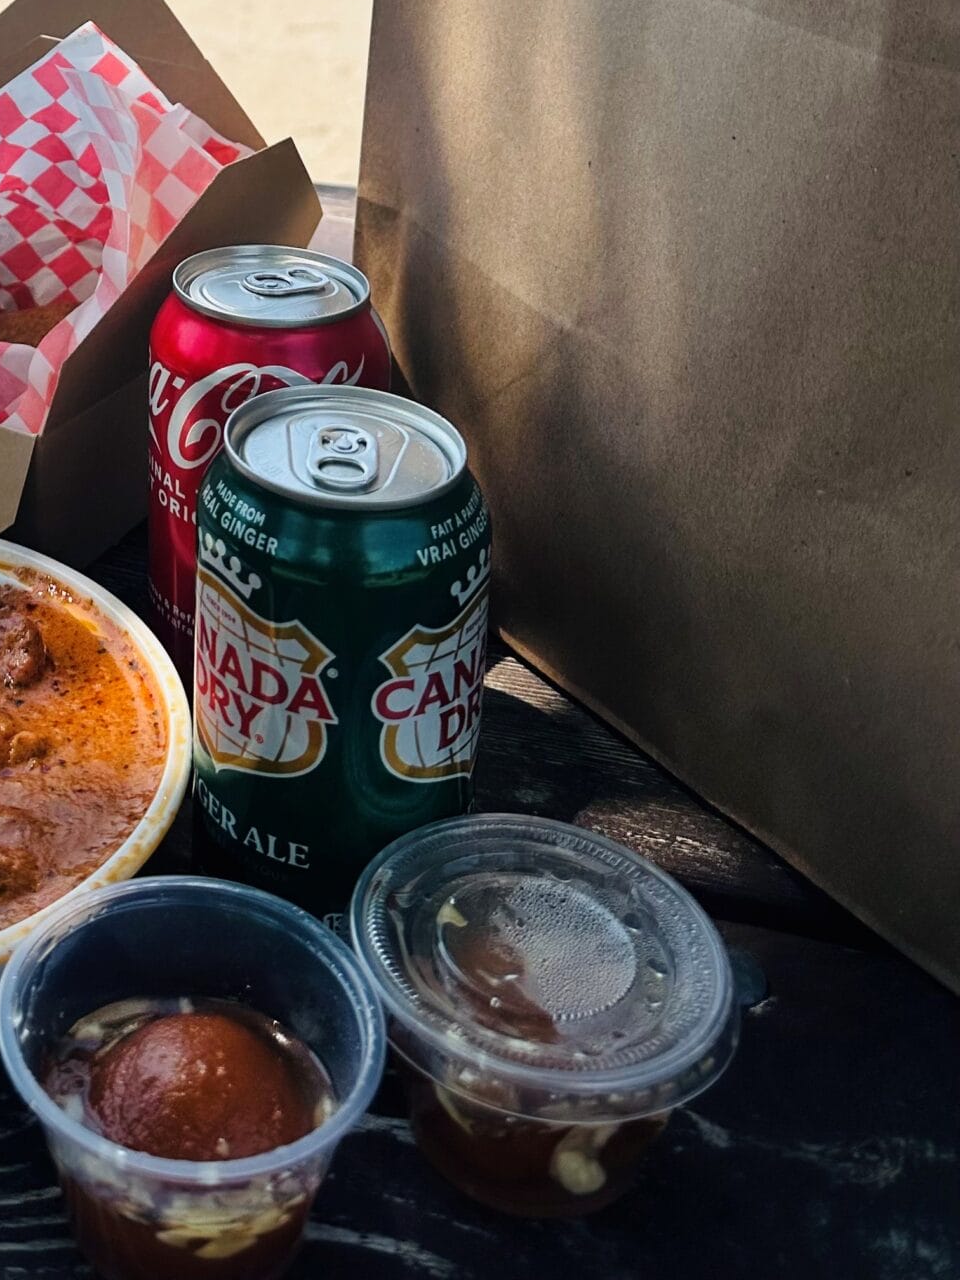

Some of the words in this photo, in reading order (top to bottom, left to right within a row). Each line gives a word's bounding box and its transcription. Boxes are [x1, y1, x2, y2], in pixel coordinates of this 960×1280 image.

[202, 484, 220, 518] REAL
[221, 511, 278, 555] GINGER
[216, 480, 237, 507] MADE
[235, 500, 265, 526] FROM
[431, 518, 453, 539] FAIT
[416, 538, 456, 566] VRAI
[196, 776, 238, 840] GER
[243, 826, 310, 869] ALE
